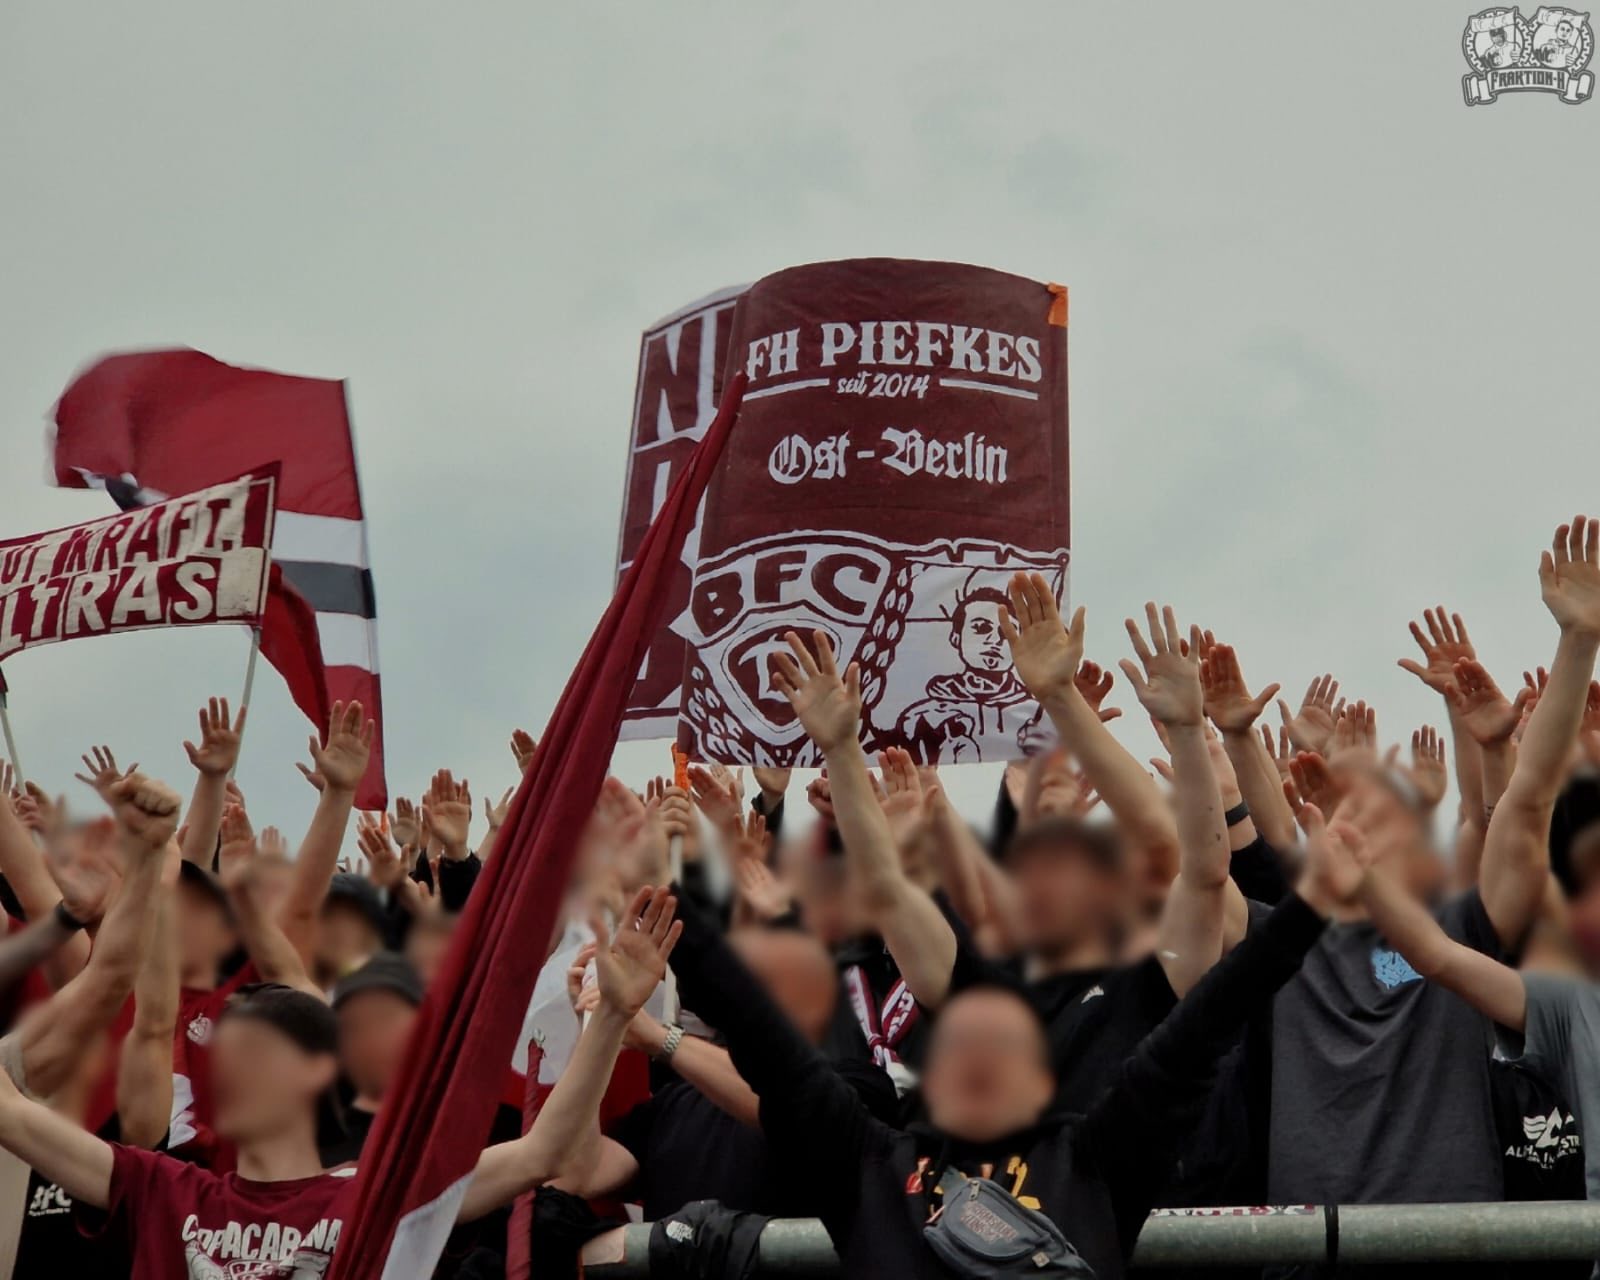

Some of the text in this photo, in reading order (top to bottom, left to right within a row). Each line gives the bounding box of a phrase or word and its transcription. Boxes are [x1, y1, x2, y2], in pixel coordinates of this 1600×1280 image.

[746, 320, 1042, 383] FH PIEFKES
[836, 371, 930, 399] seit 2014
[691, 550, 882, 638] BFC
